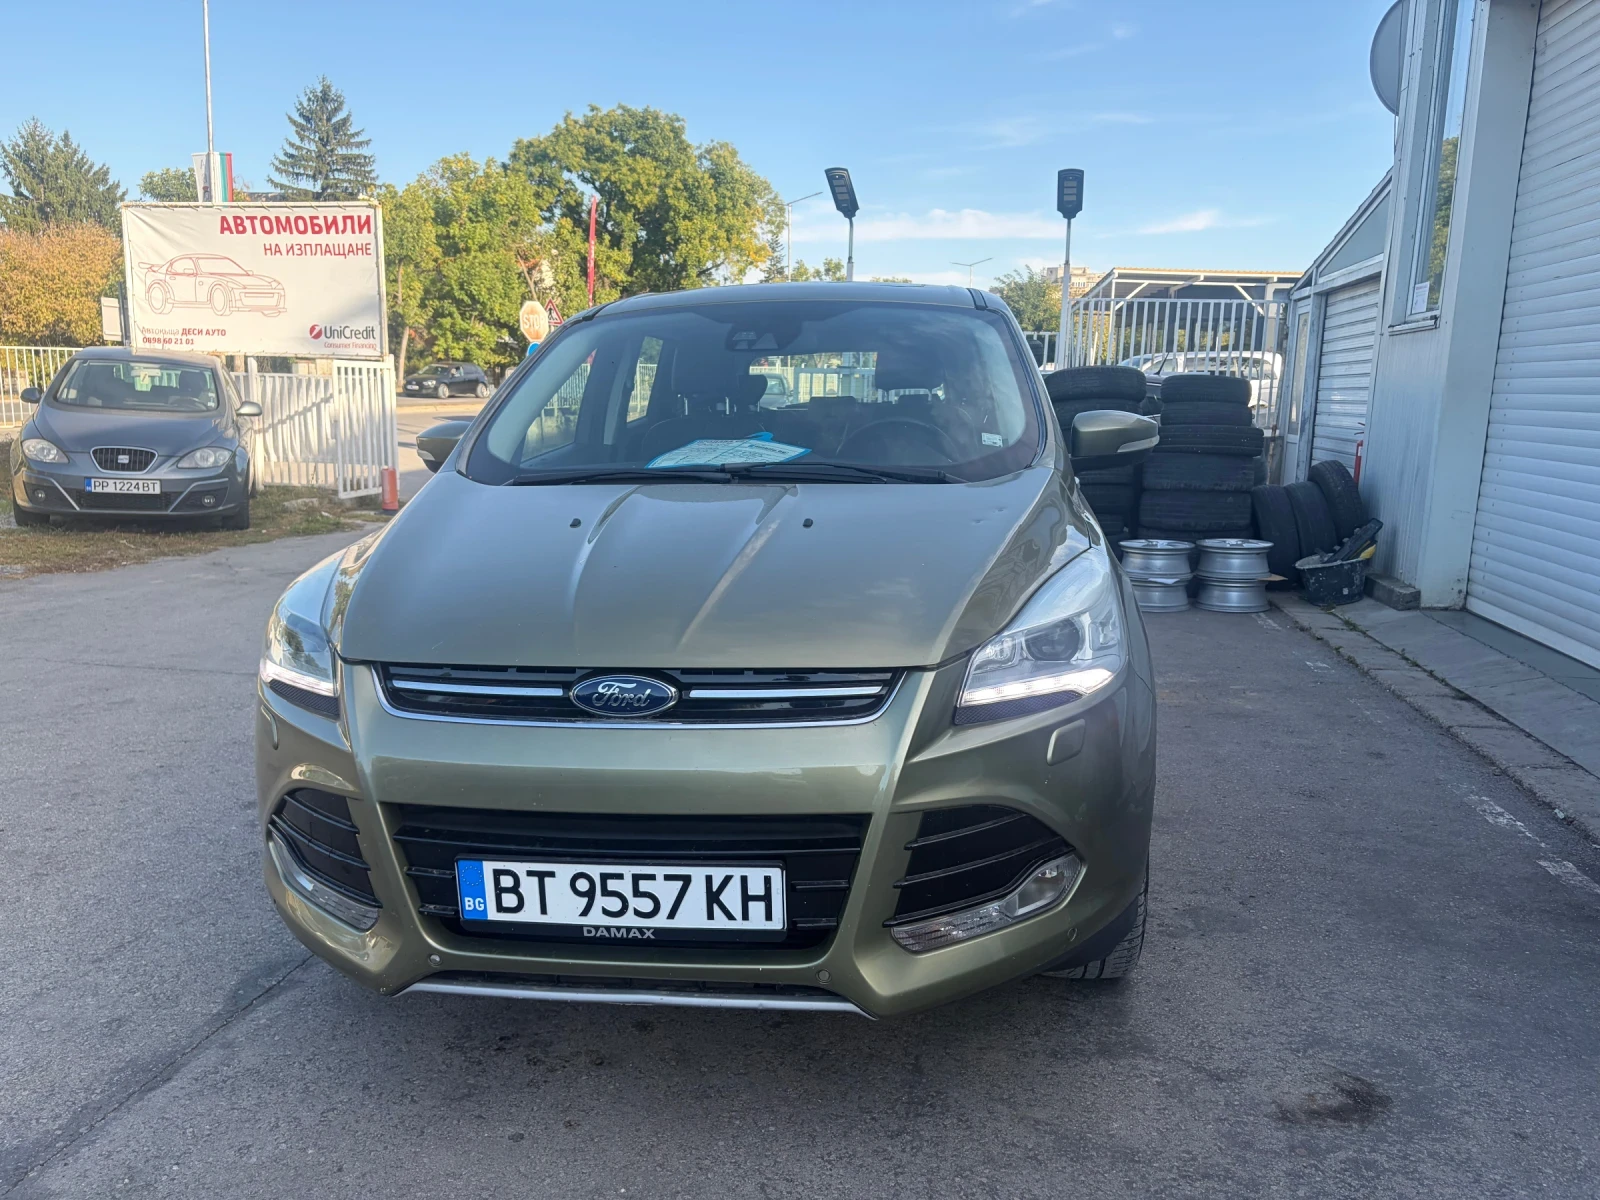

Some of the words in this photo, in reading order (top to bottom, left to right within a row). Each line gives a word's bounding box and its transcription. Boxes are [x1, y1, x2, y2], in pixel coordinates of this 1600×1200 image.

[219, 214, 372, 235] АВТОМОБИЛИ
[263, 243, 282, 256] НА
[285, 242, 372, 259] ИЗПЛАЩАНЕ
[523, 313, 546, 329] STOP
[181, 327, 204, 337] ДЕСИ
[205, 328, 227, 337] АУТО
[324, 325, 376, 340] UniCredit
[163, 337, 173, 345] 60
[93, 480, 109, 491] PP
[112, 481, 140, 492] 1224
[142, 481, 158, 492] BT
[592, 681, 651, 707] Ford
[492, 867, 557, 916] BT
[569, 871, 693, 921] 9557
[704, 873, 773, 922] KH
[464, 897, 485, 912] BG
[582, 926, 656, 940] DAMAX
